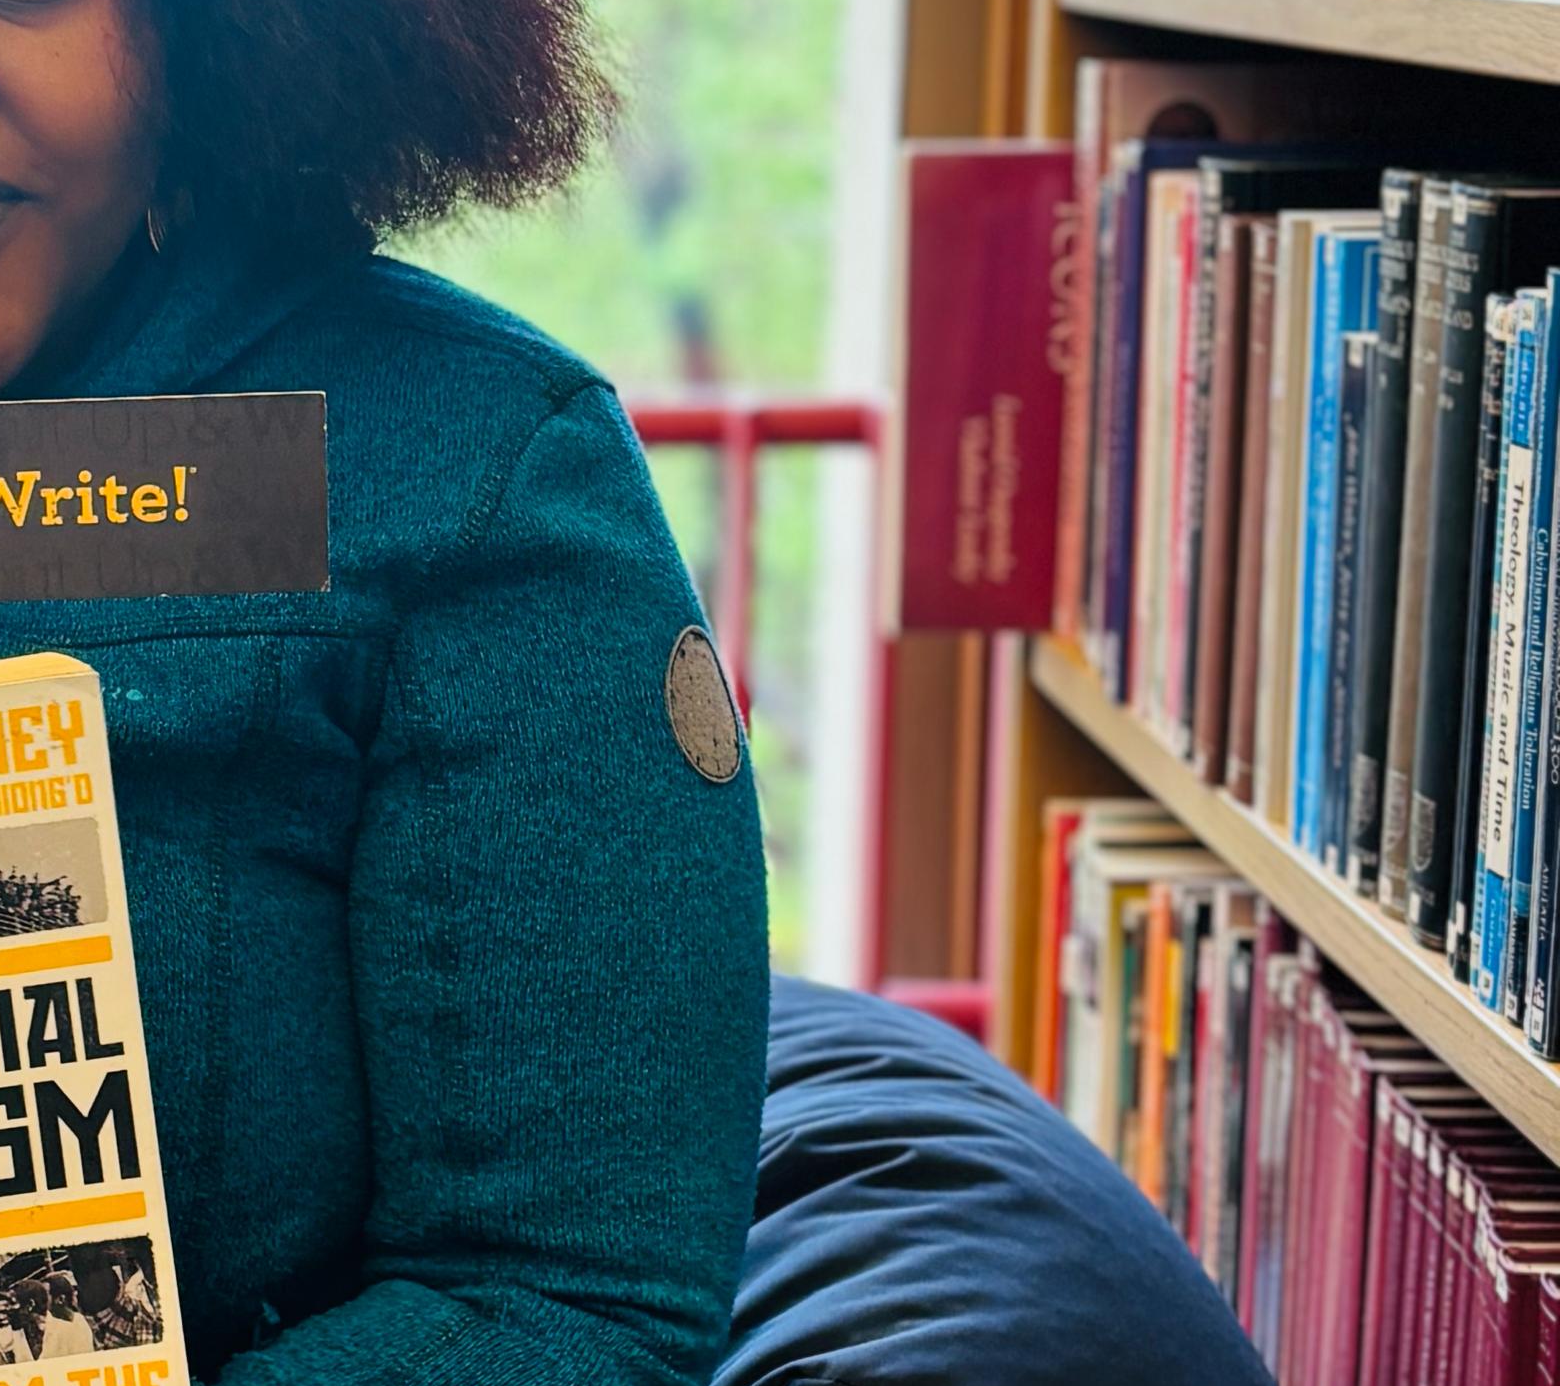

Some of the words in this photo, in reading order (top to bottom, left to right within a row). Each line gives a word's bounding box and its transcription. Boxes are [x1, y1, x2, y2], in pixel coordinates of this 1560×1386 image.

[1501, 481, 1525, 609] Theology,
[1532, 527, 1550, 611] Calvinism
[1497, 623, 1517, 705] Music
[1531, 614, 1544, 647] and
[1526, 649, 1543, 724] Religious
[1496, 714, 1510, 766] and
[1520, 728, 1538, 811] Toleration
[1492, 775, 1508, 843] Time
